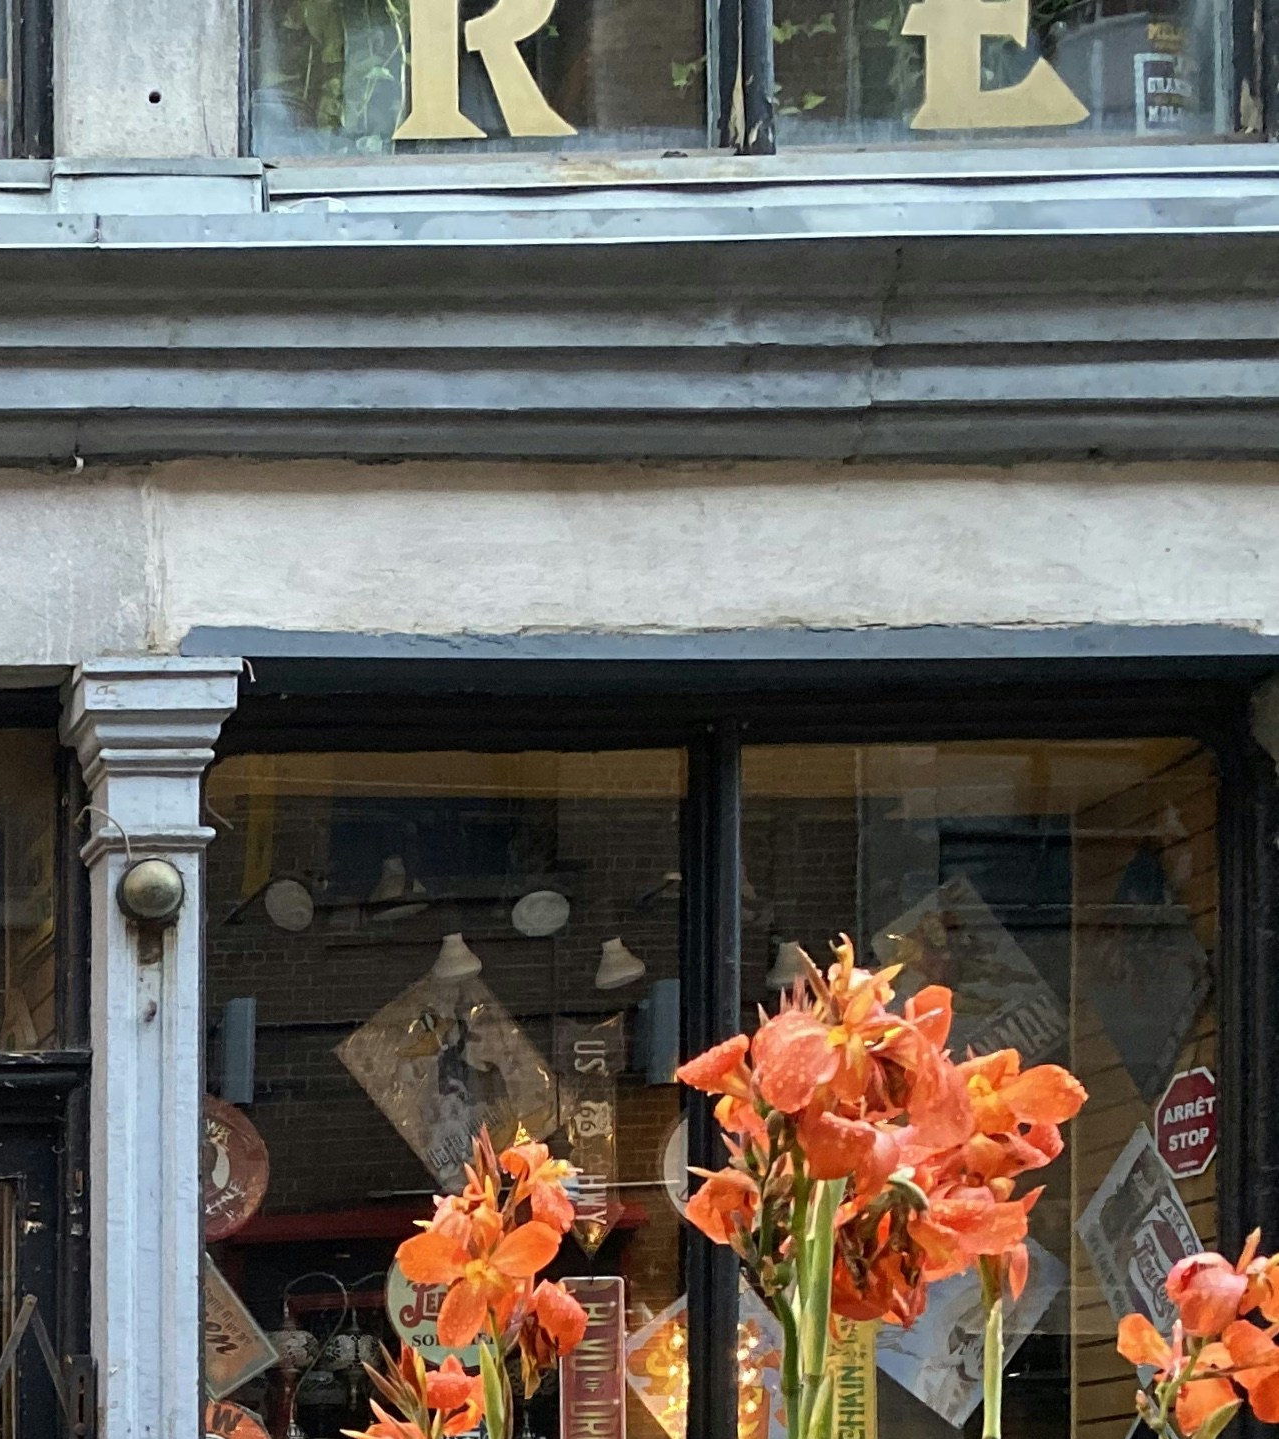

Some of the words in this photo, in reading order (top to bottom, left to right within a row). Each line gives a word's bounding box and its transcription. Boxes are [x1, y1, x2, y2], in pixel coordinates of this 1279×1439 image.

[574, 1040, 609, 1077] US
[1163, 1096, 1216, 1125] ARRÊT
[1168, 1127, 1209, 1151] STOP
